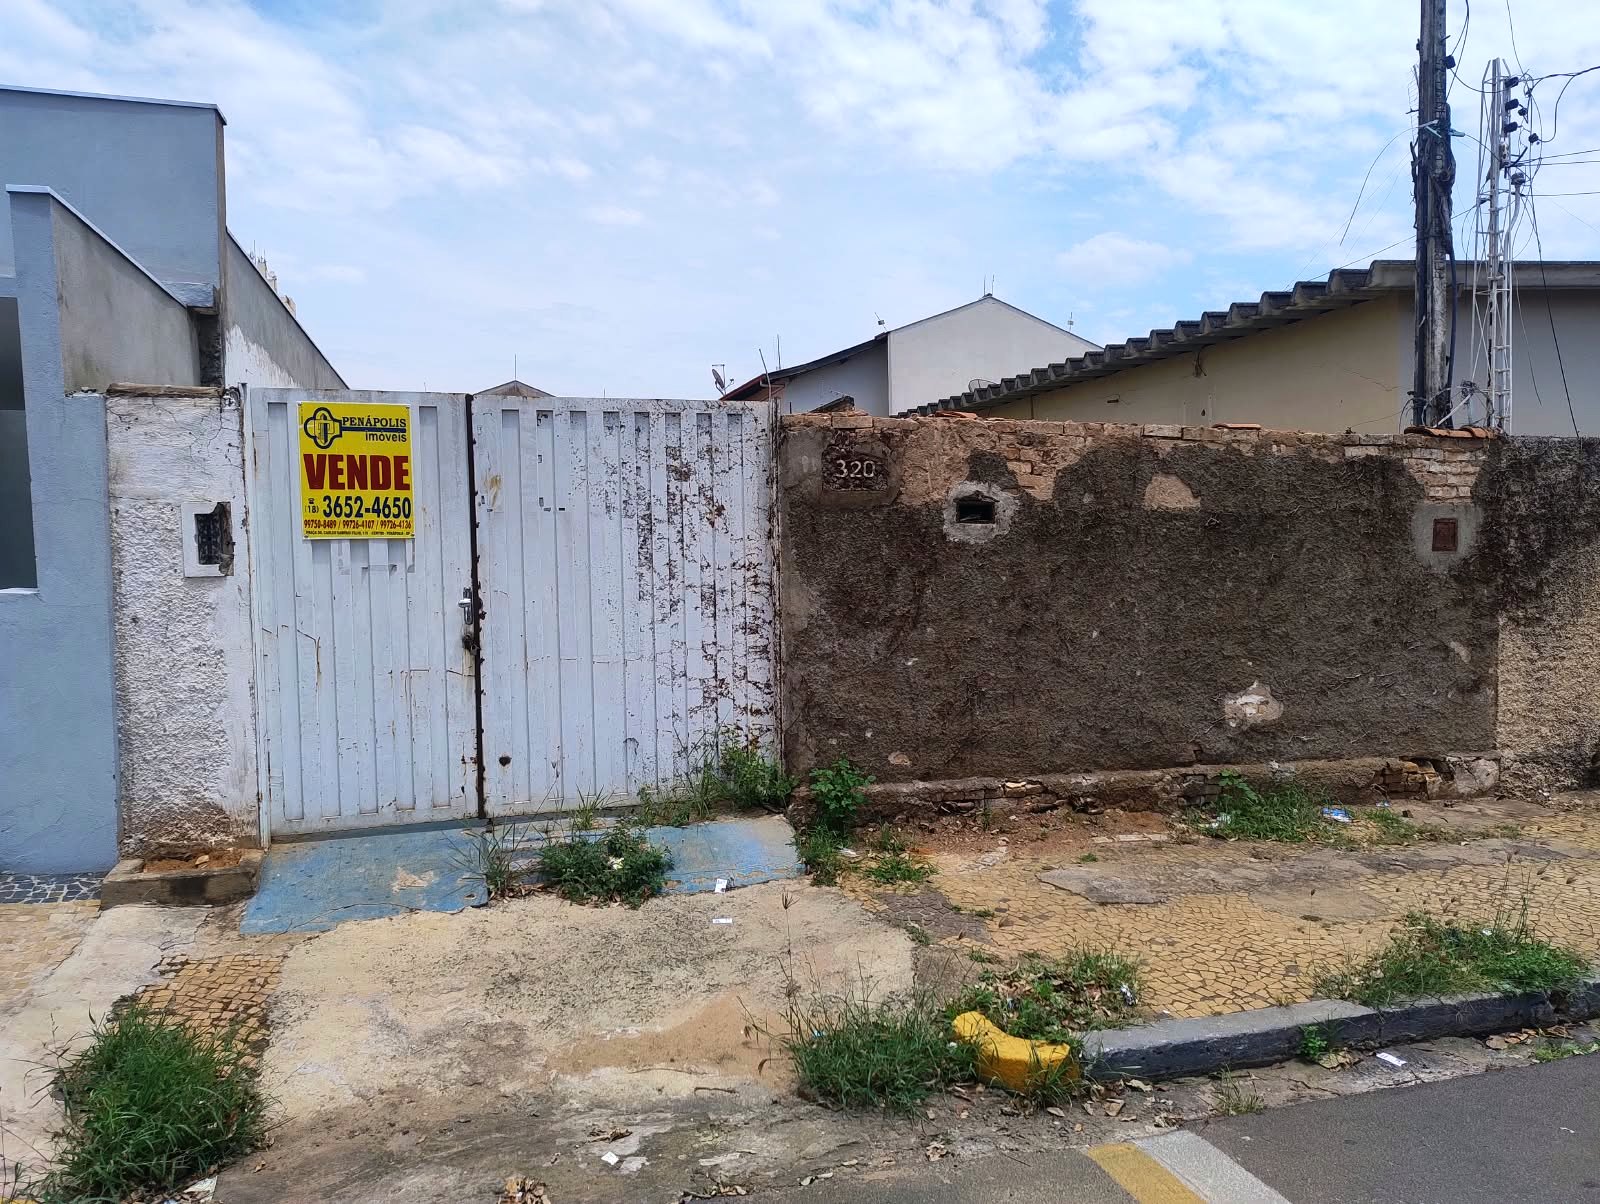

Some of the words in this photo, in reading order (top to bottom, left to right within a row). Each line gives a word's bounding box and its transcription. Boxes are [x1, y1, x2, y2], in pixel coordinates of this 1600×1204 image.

[342, 415, 407, 428] PENÁPOLIS
[365, 430, 407, 442] imóveis
[303, 454, 410, 490] VENDE
[834, 459, 875, 478] 320
[304, 505, 319, 514] (18)
[322, 495, 412, 519] 3652-4650
